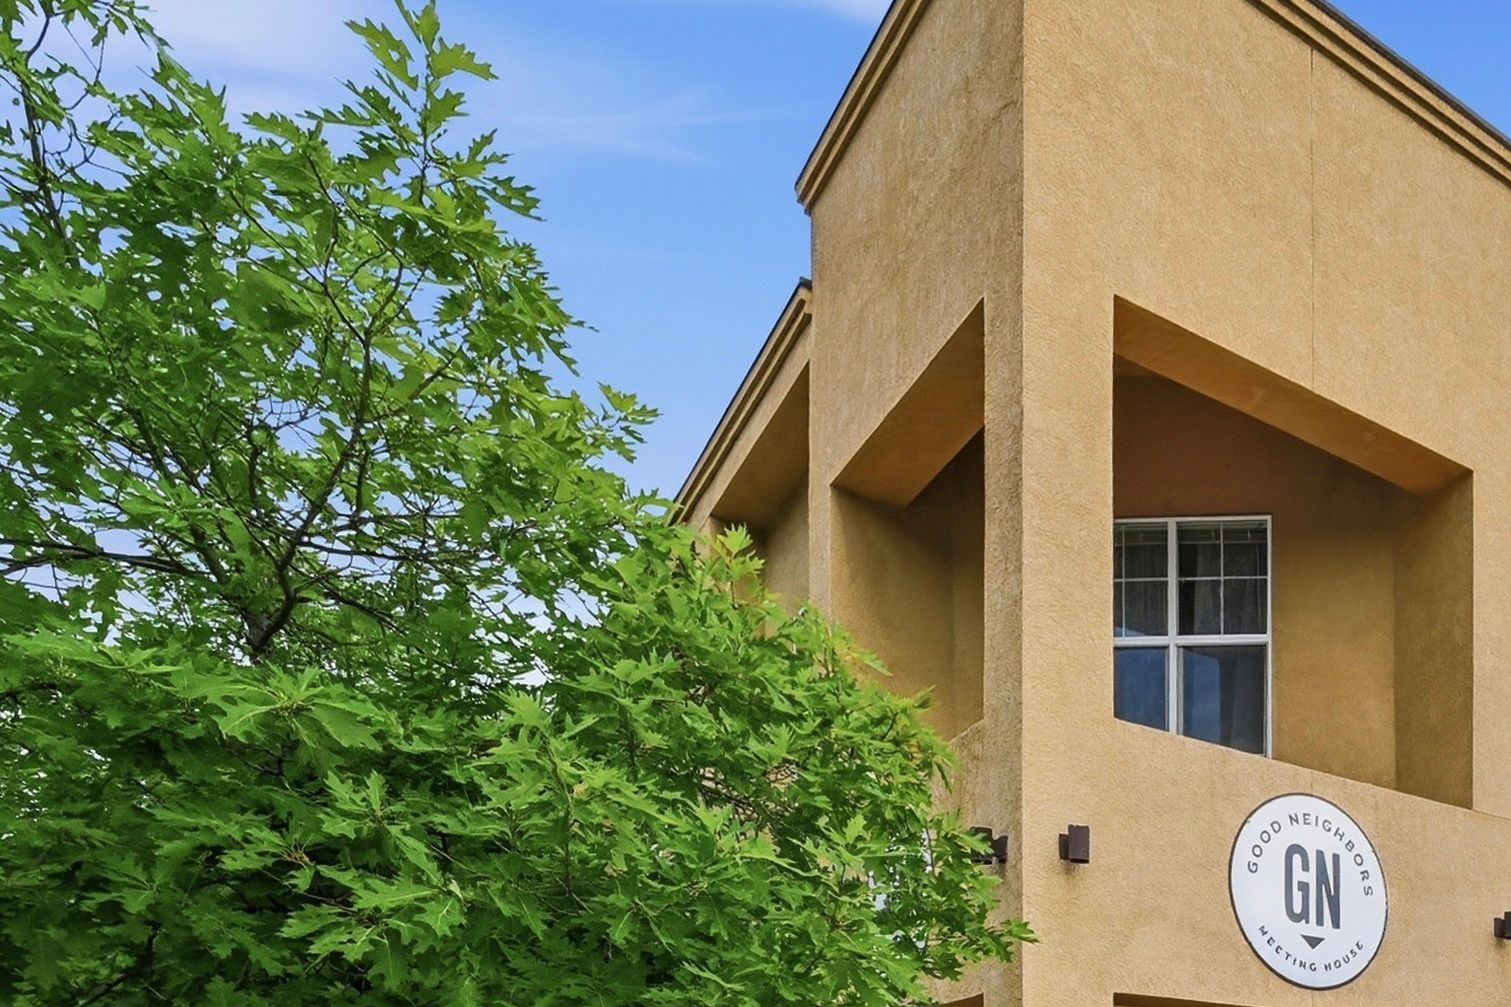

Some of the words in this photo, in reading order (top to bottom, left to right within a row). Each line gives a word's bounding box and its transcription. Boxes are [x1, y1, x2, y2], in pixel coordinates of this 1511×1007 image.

[1247, 820, 1282, 874] GOOD
[1288, 813, 1373, 897] NEIGHBORS
[1284, 843, 1341, 930] GN
[1258, 925, 1317, 972] MEETING
[1324, 940, 1364, 972] HOUSE
